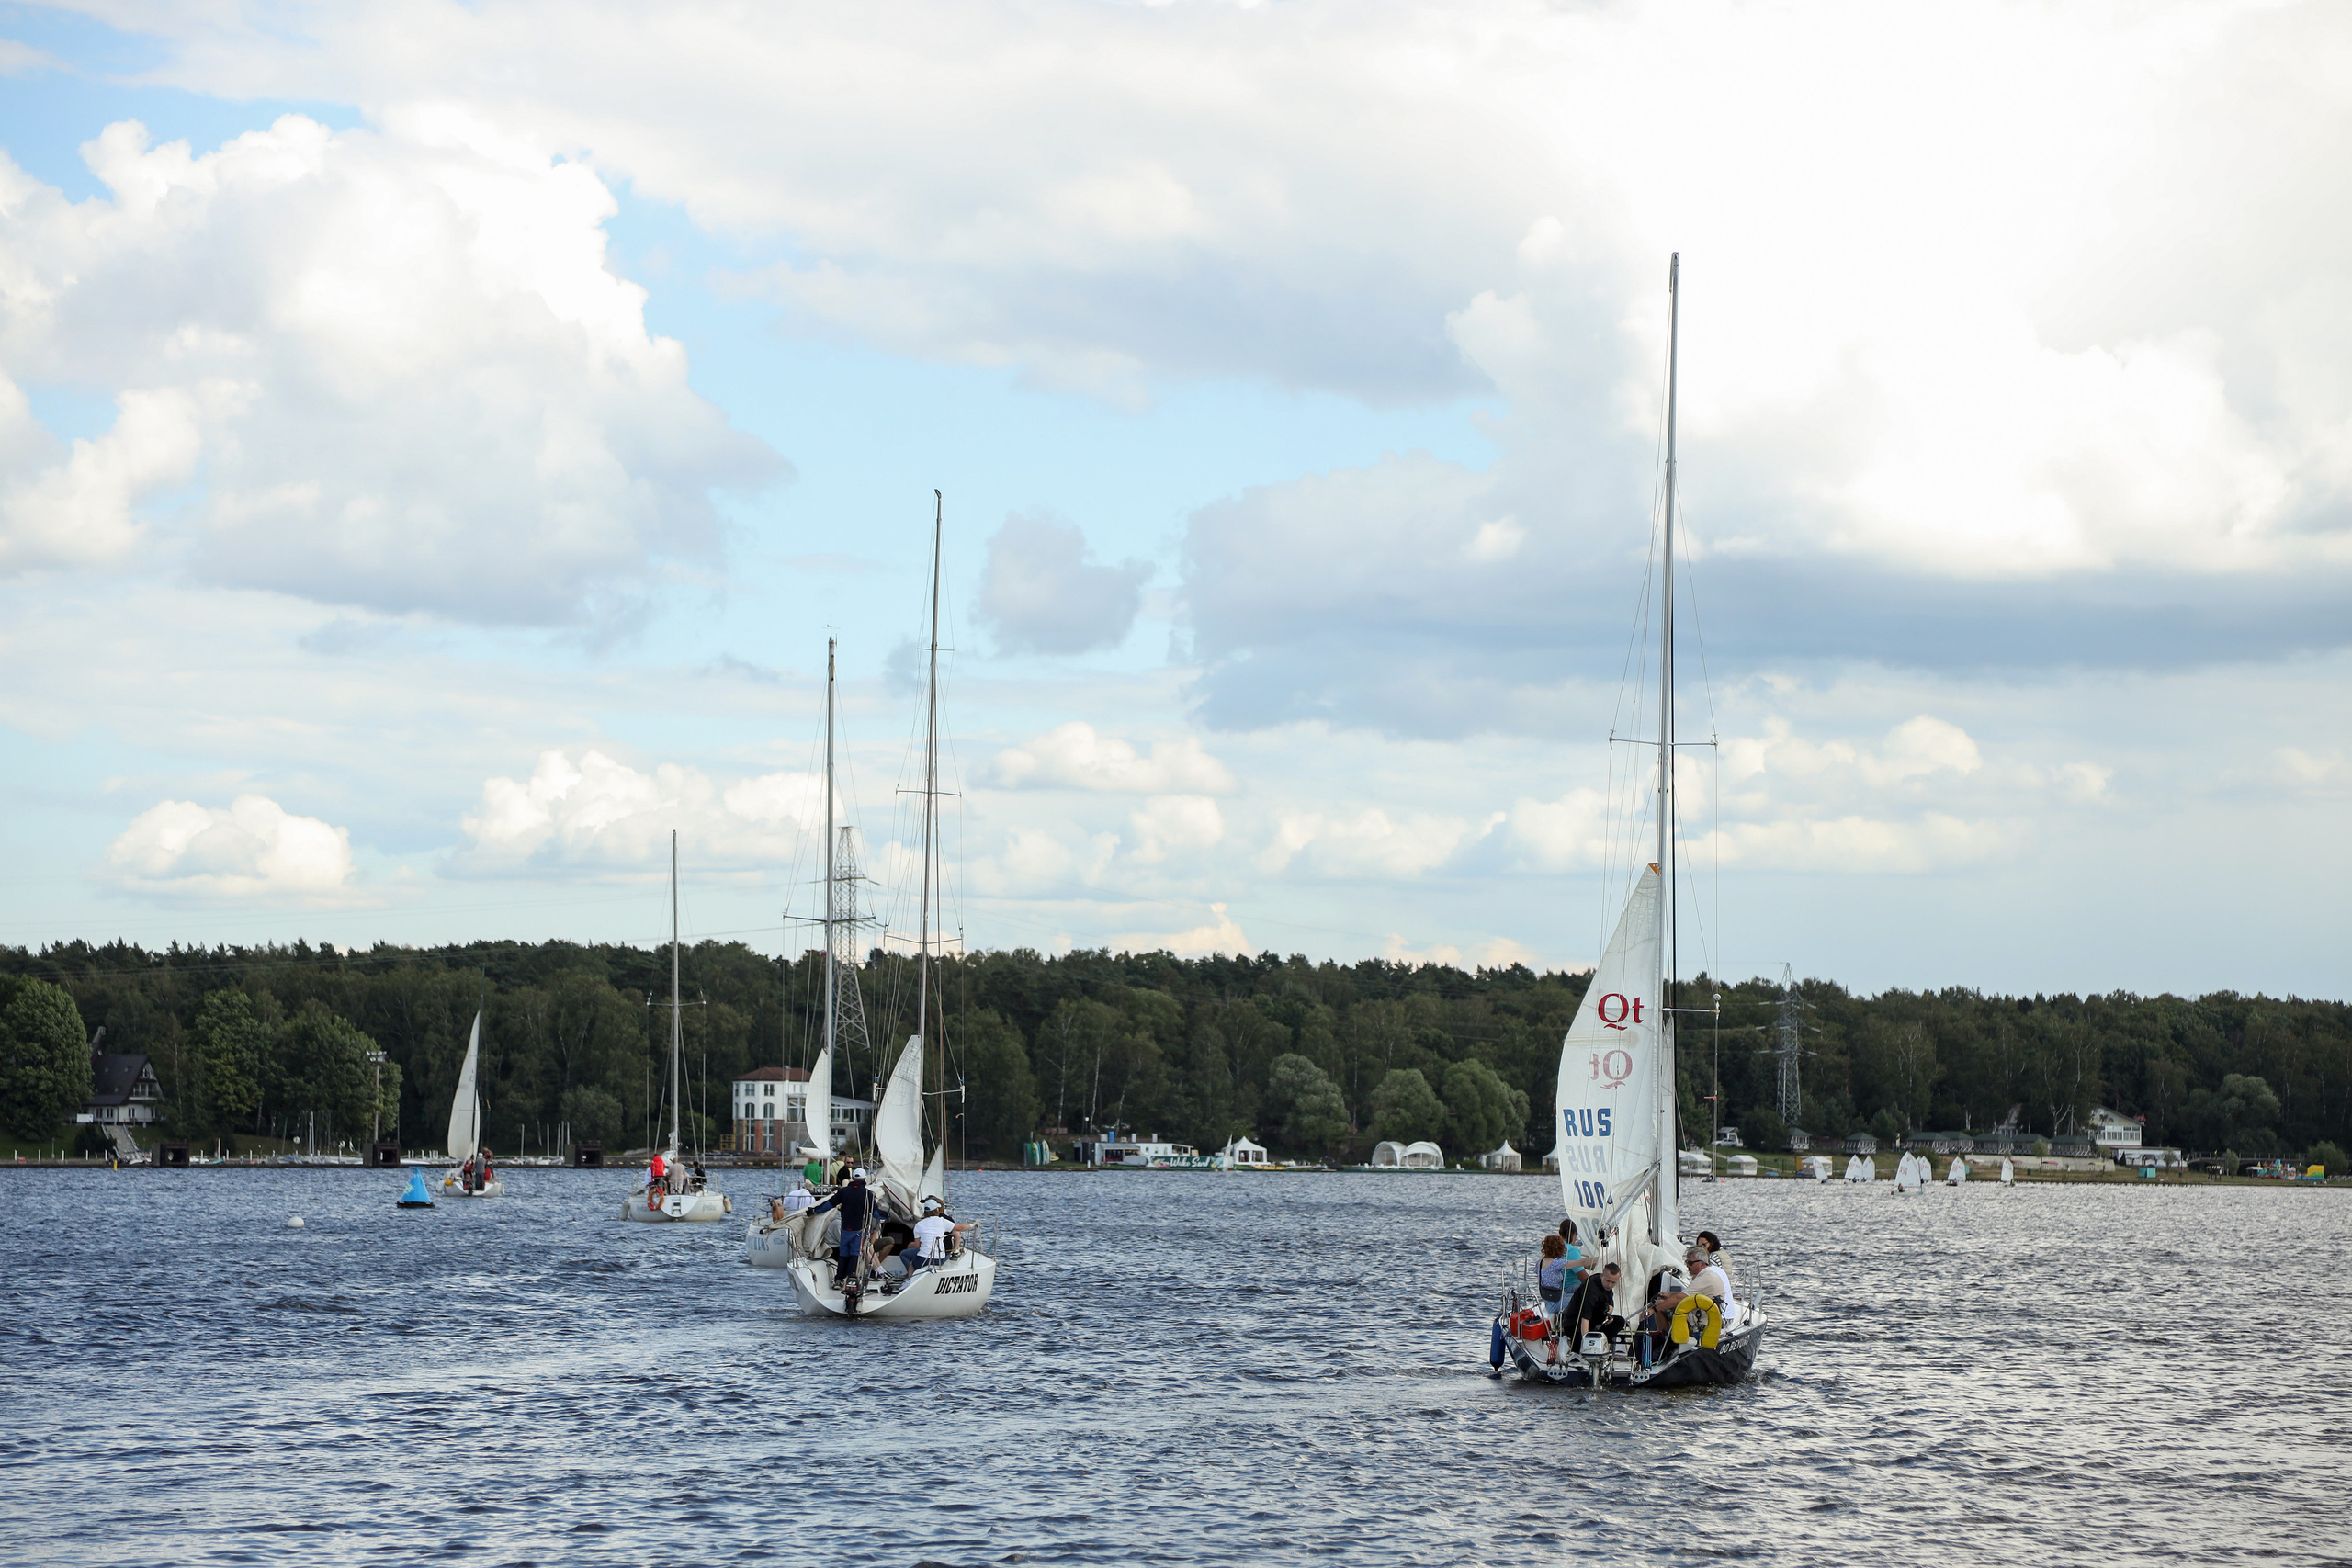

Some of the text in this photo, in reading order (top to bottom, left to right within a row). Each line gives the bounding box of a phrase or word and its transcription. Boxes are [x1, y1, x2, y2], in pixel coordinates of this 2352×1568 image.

[1598, 993, 1645, 1031] Qt
[1563, 1108, 1611, 1137] RUS
[934, 1273, 978, 1295] DICTATOR
[1719, 1343, 1730, 1355] GO
